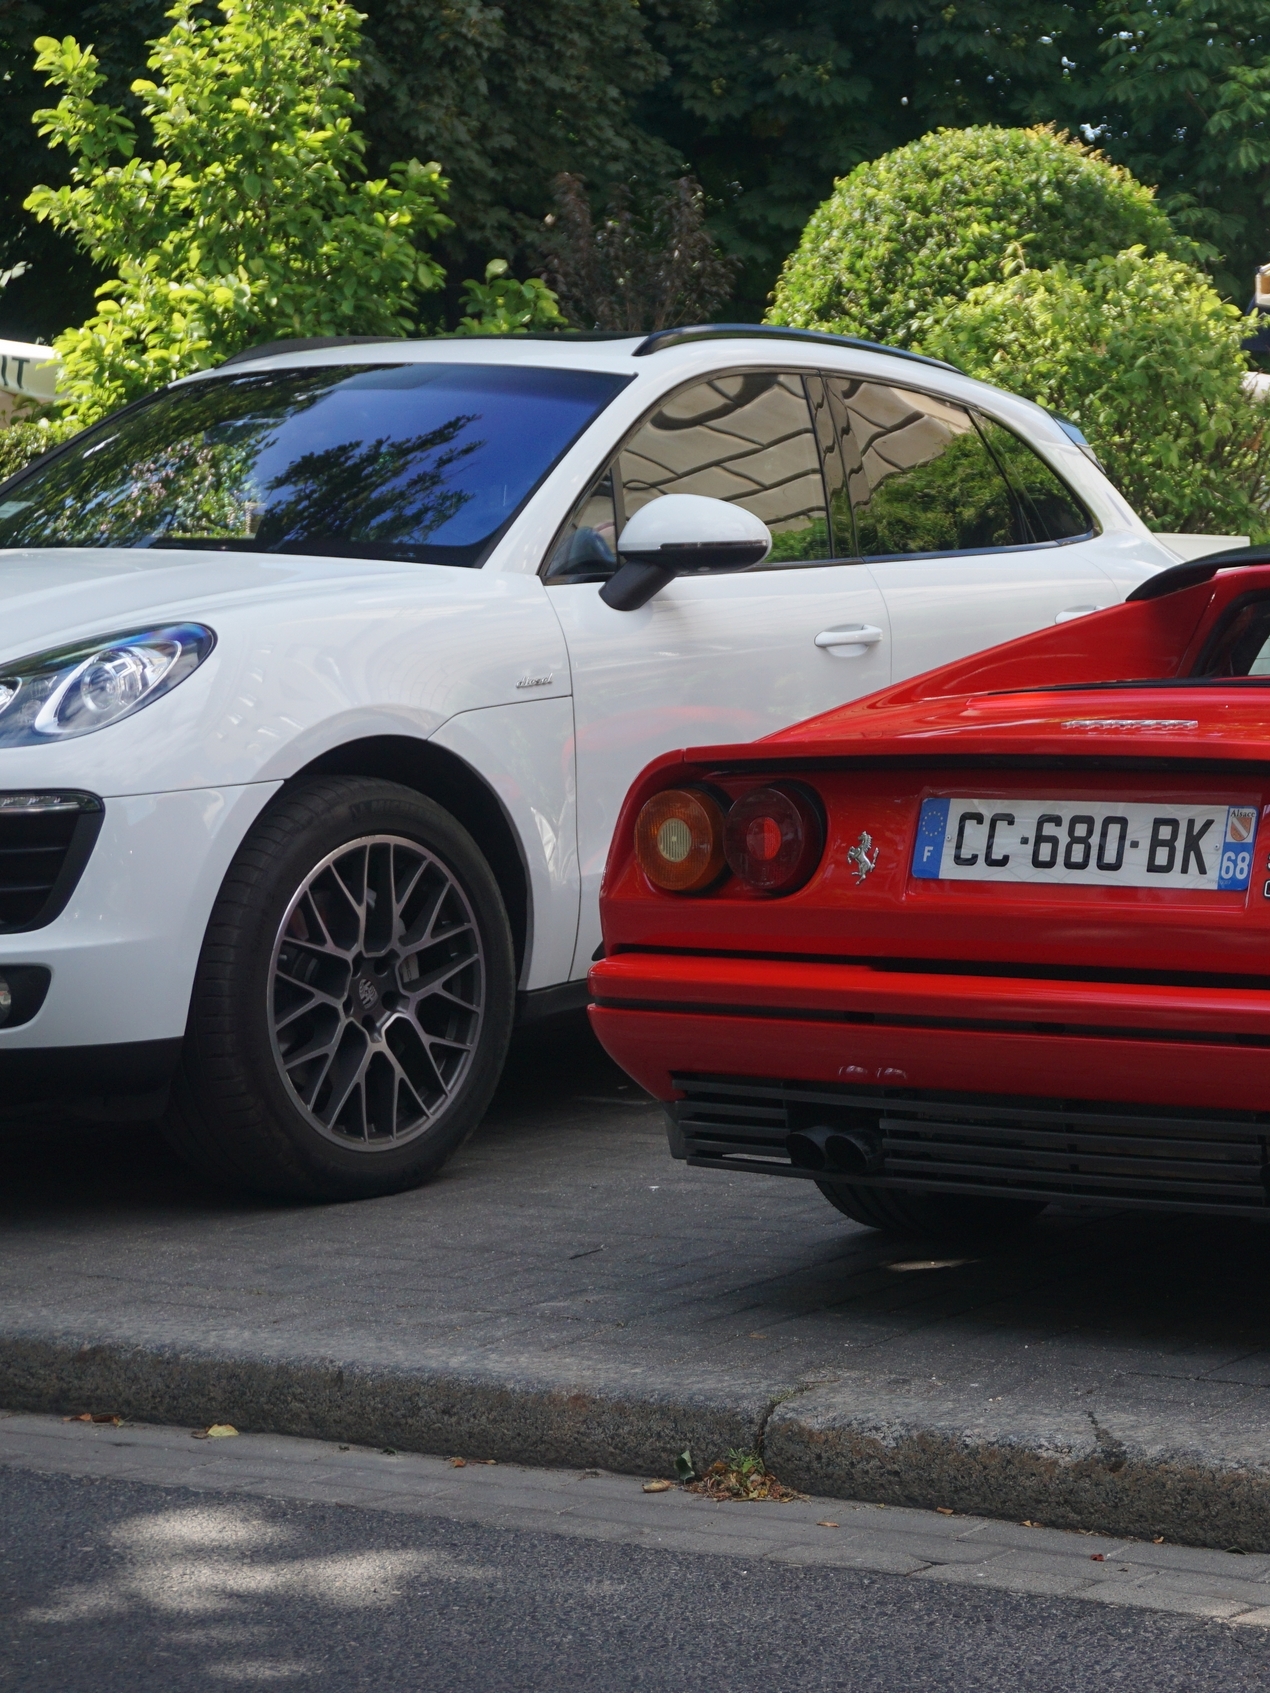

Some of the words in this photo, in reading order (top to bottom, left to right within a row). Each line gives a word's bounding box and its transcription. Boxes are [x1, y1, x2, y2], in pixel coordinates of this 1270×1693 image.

[1230, 809, 1255, 819] Alsace
[922, 846, 933, 862] F
[1221, 852, 1250, 880] 68
